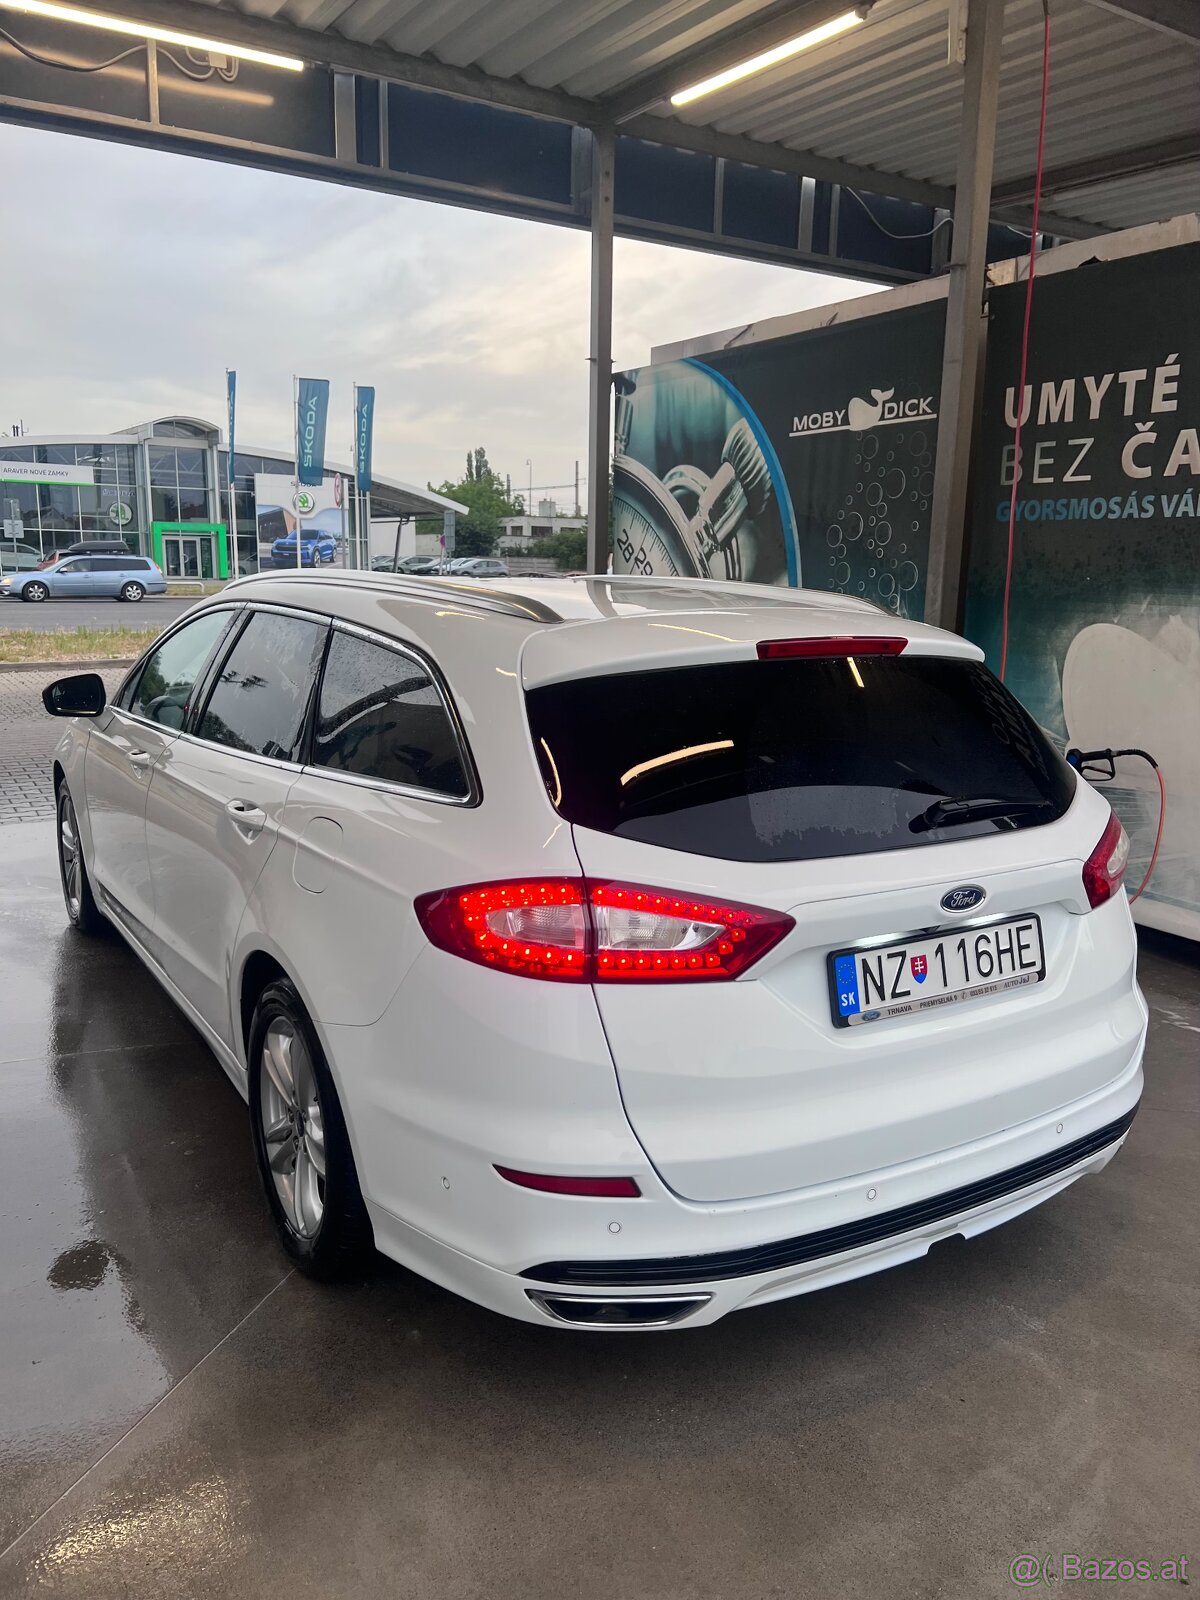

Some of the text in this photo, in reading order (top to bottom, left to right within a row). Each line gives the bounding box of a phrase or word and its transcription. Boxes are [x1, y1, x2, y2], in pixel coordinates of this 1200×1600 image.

[1004, 353, 1181, 428] UMYTÉ
[792, 396, 934, 431] MOBY DICK
[304, 396, 318, 468] ŠKODA
[1000, 421, 1200, 486] BEZ ČA
[996, 488, 1200, 522] GYORSMOSÁS VÁ
[617, 528, 634, 563] 28
[950, 890, 976, 908] Ford
[861, 924, 1037, 1005] NZ 116HE
[841, 991, 856, 1007] SK
[887, 1005, 913, 1015] TRNAVA
[1004, 979, 1019, 988] AUTO
